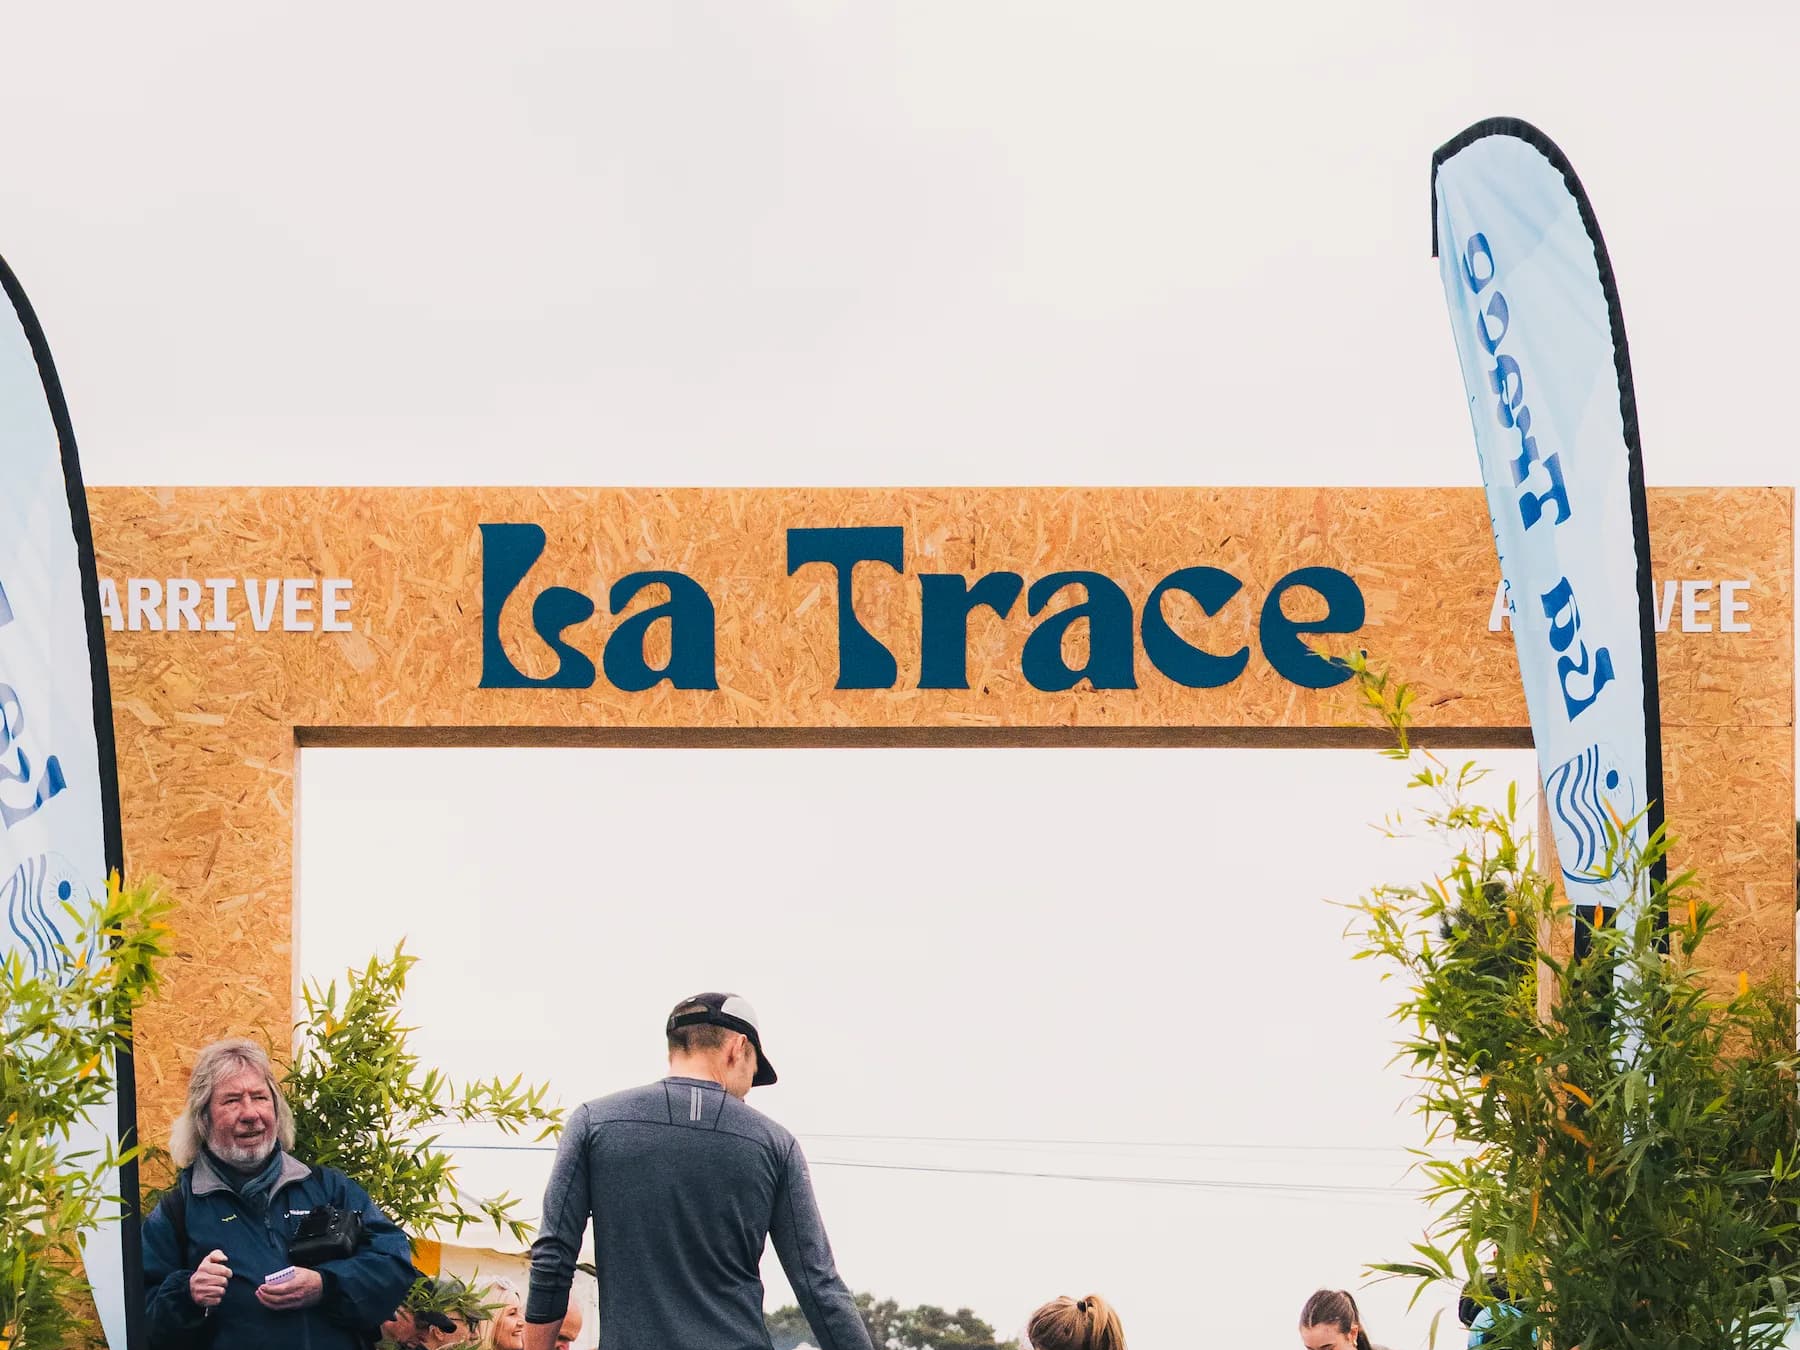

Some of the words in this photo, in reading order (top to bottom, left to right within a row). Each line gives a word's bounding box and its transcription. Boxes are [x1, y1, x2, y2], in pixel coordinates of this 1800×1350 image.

[99, 578, 353, 632] ARRIVEE
[478, 523, 719, 692] La
[787, 526, 1367, 691] Trace
[1488, 580, 1751, 633] AVEE
